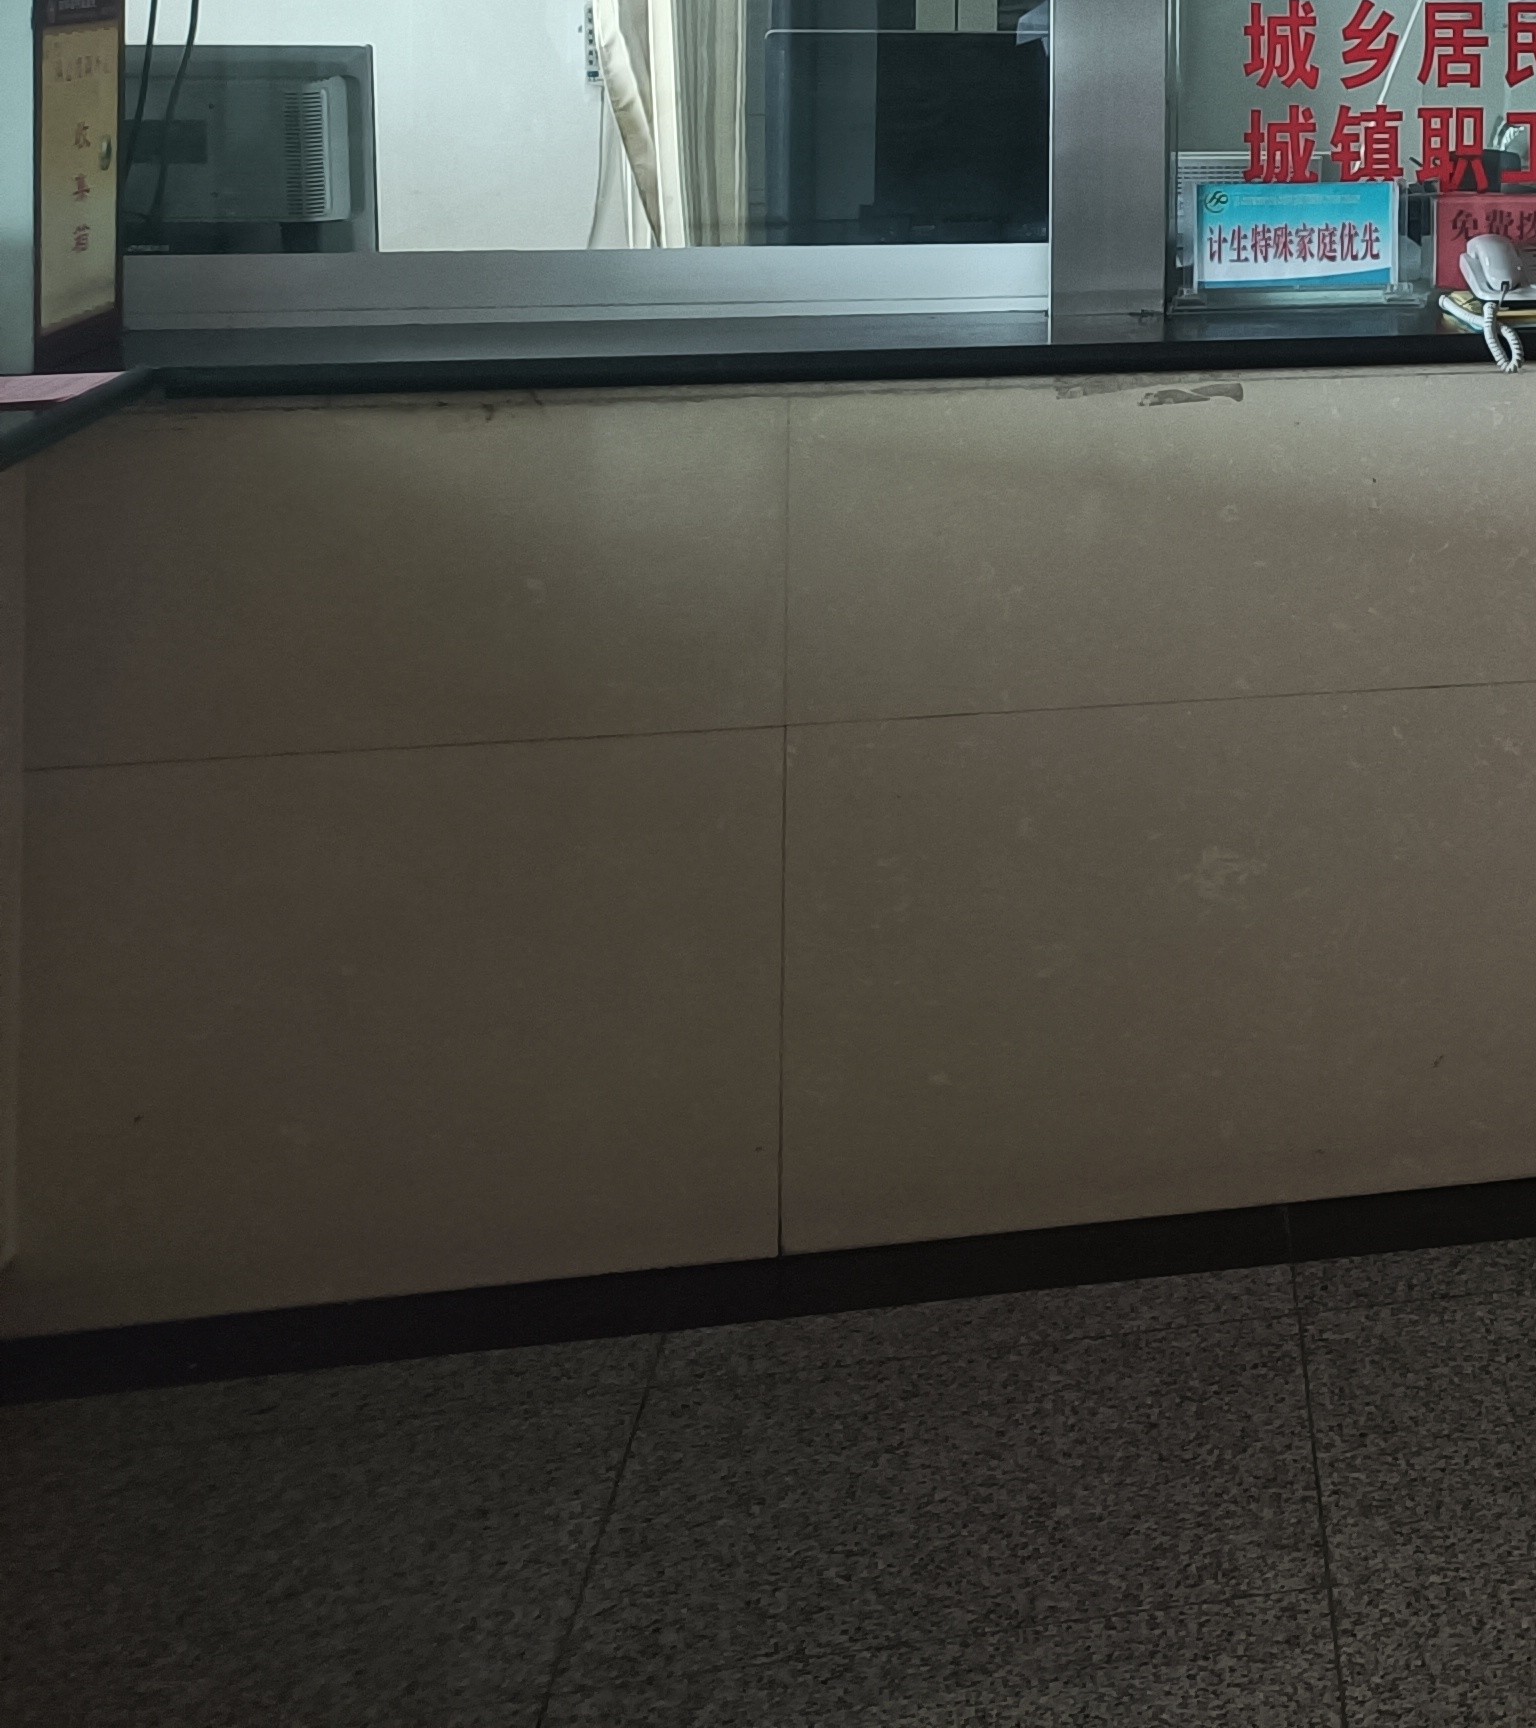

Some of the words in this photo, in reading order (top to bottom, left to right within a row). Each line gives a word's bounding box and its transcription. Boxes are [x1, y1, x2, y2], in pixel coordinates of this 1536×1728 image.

[1206, 221, 1382, 264] 计生特殊家庭优先
